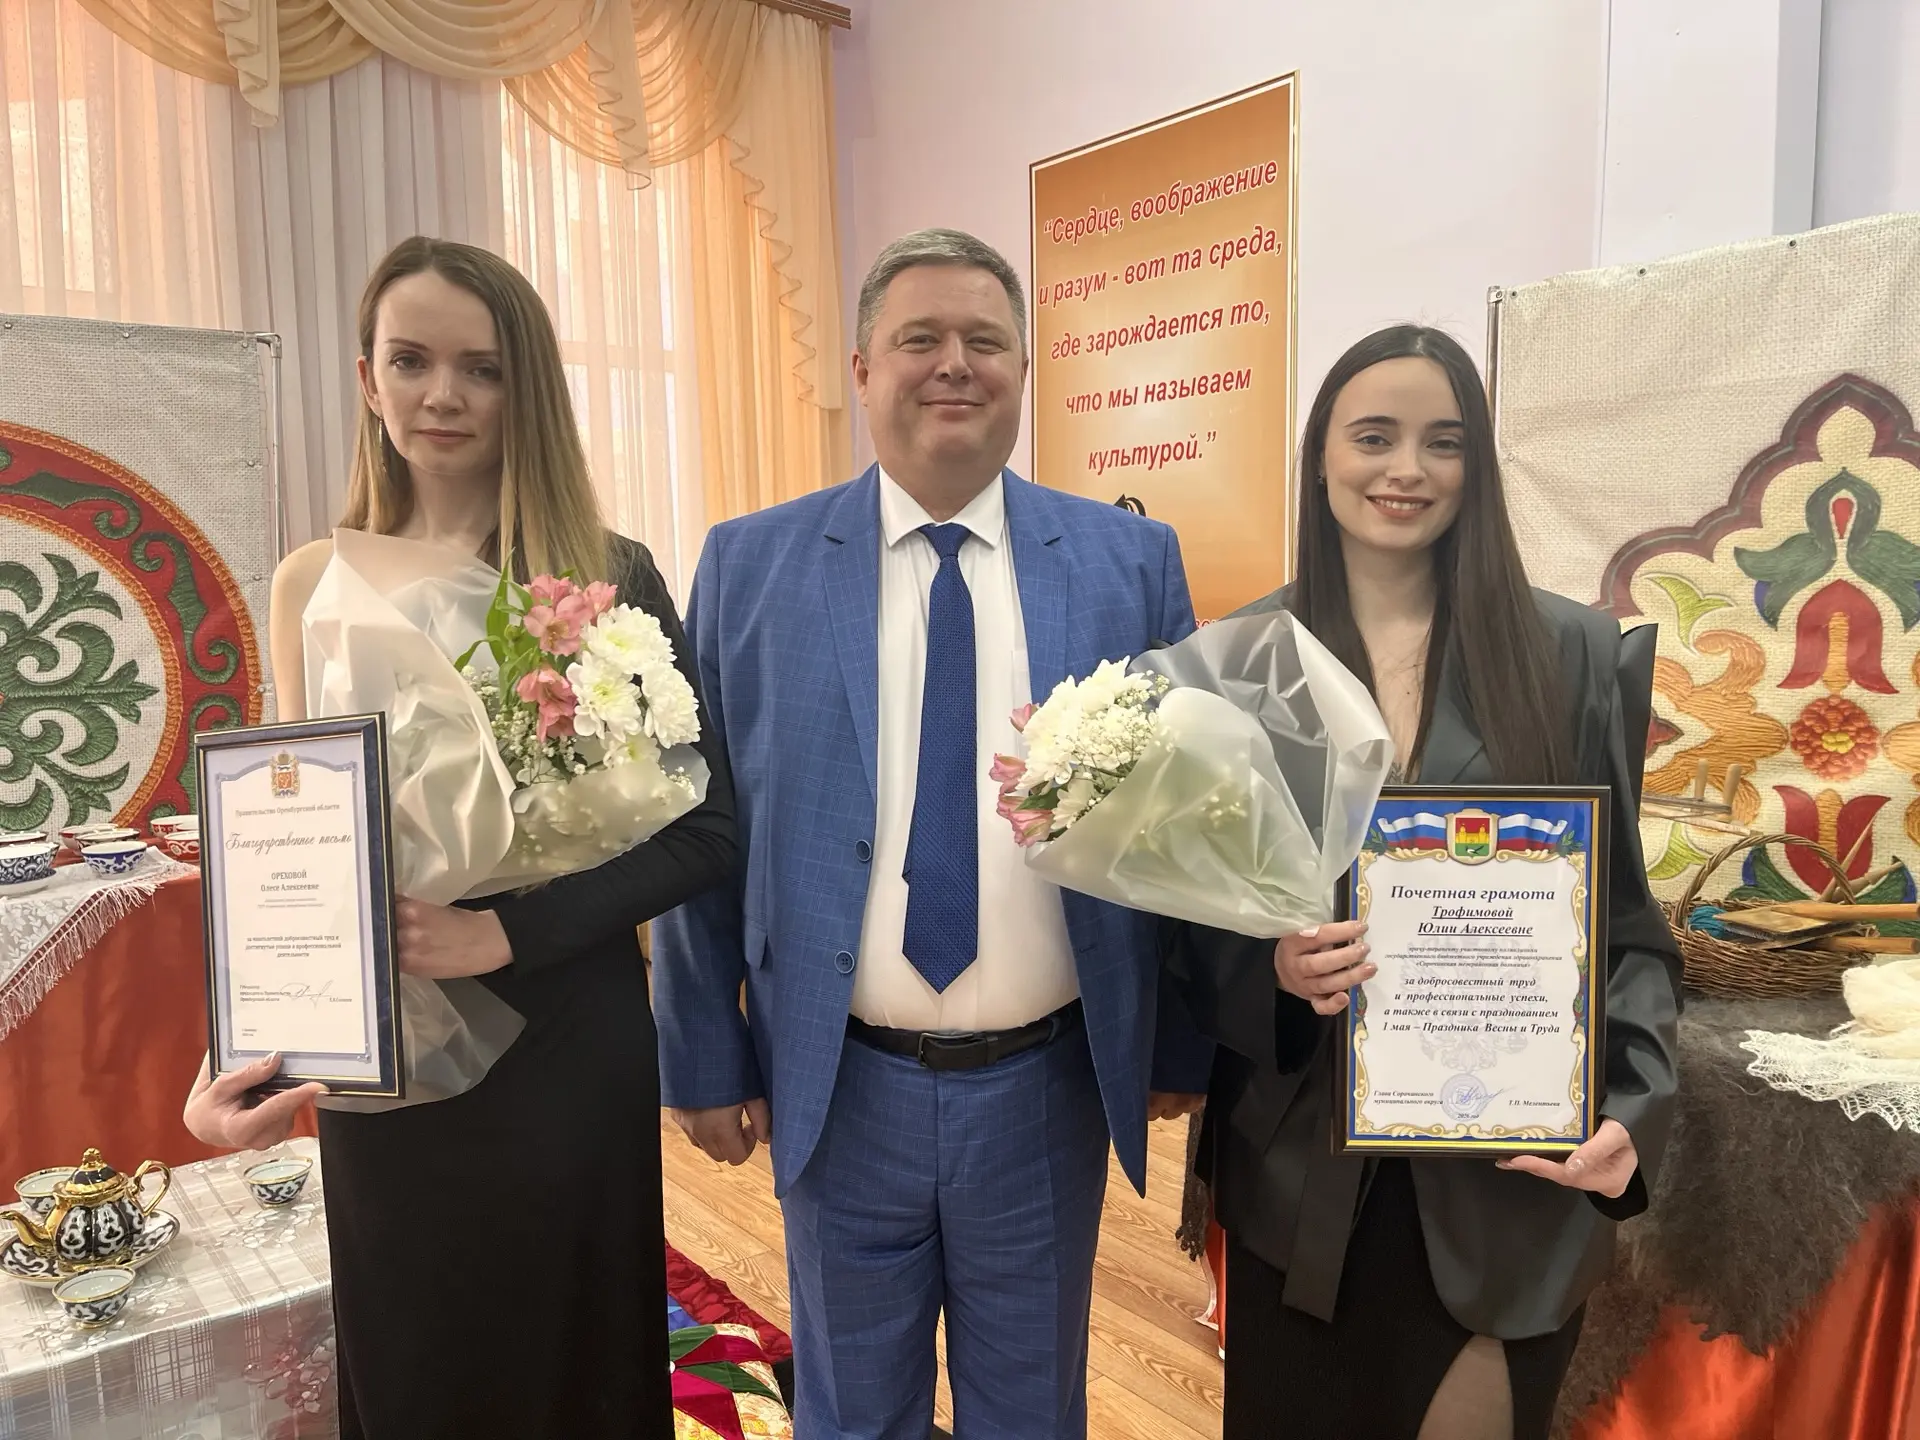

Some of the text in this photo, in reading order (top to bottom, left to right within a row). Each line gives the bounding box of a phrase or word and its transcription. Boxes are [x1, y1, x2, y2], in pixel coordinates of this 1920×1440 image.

[1045, 161, 1277, 243] “Сердце, воображение
[1039, 286, 1048, 305] и
[1054, 272, 1106, 307] разум
[1125, 260, 1165, 284] вот
[1172, 249, 1201, 273] та
[1209, 226, 1282, 270] среда,
[1051, 300, 1270, 360] где зарождается то,
[1066, 368, 1252, 414] что мы называем
[1088, 431, 1217, 475] культурой.”
[226, 831, 352, 855] Благодарственное письмо
[271, 869, 307, 880] ОРЕХОВОЙ
[261, 883, 319, 892] Олесе Алексеевне
[1390, 885, 1555, 902] Почетная грамота
[1432, 906, 1513, 919] Трофимовой
[1418, 922, 1533, 937] Юлии Алексеевне
[1404, 976, 1536, 988] за добросовестный труд
[1406, 992, 1505, 1004] профессиональные
[1509, 994, 1548, 1004] успехи,
[1393, 1008, 1430, 1016] также
[1441, 1009, 1468, 1017] связи
[1471, 1009, 1477, 1017] с
[1479, 1008, 1558, 1020] празднованием
[1383, 1022, 1387, 1031] 1
[1423, 1022, 1479, 1034] Праздника
[1484, 1023, 1517, 1033] Весны
[1530, 1024, 1560, 1035] Труда
